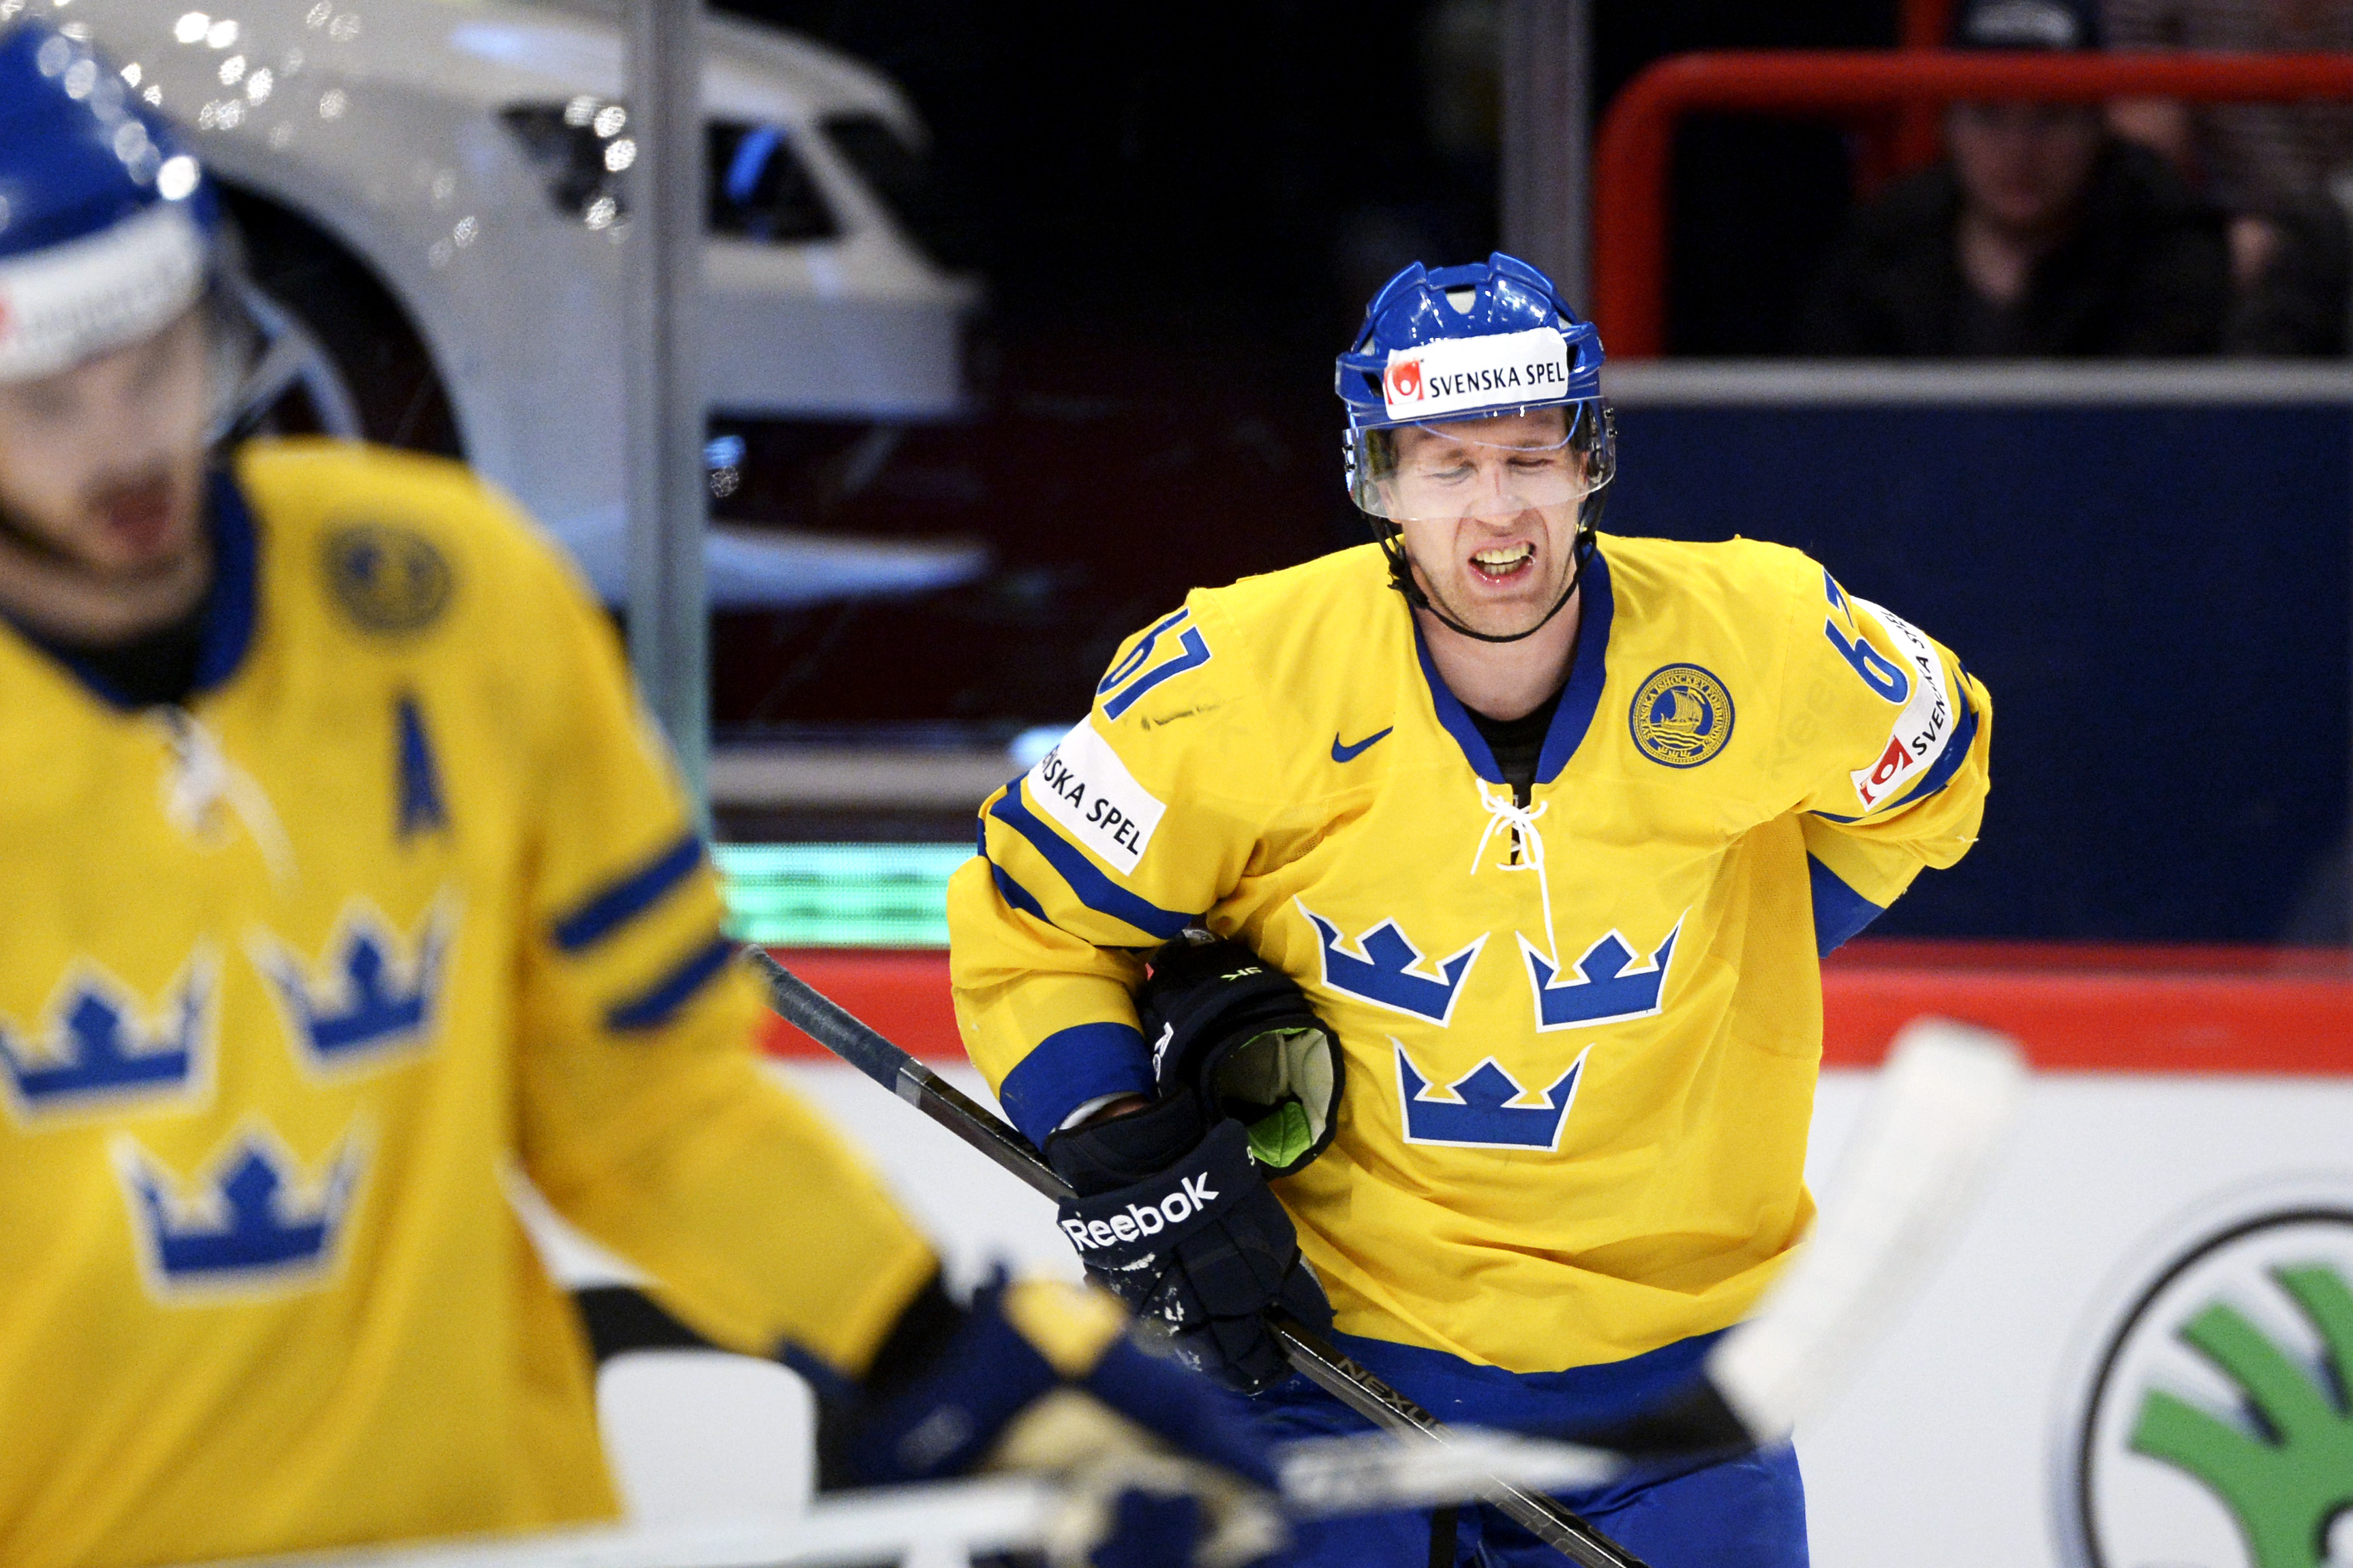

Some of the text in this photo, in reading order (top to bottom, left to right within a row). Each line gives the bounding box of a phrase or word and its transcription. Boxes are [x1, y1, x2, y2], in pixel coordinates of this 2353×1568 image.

[1429, 362, 1565, 398] SVENSKA SPEL
[1086, 798, 1140, 856] SPEL
[1061, 1171, 1219, 1251] Reebok
[1337, 1358, 1445, 1434] NEXU
